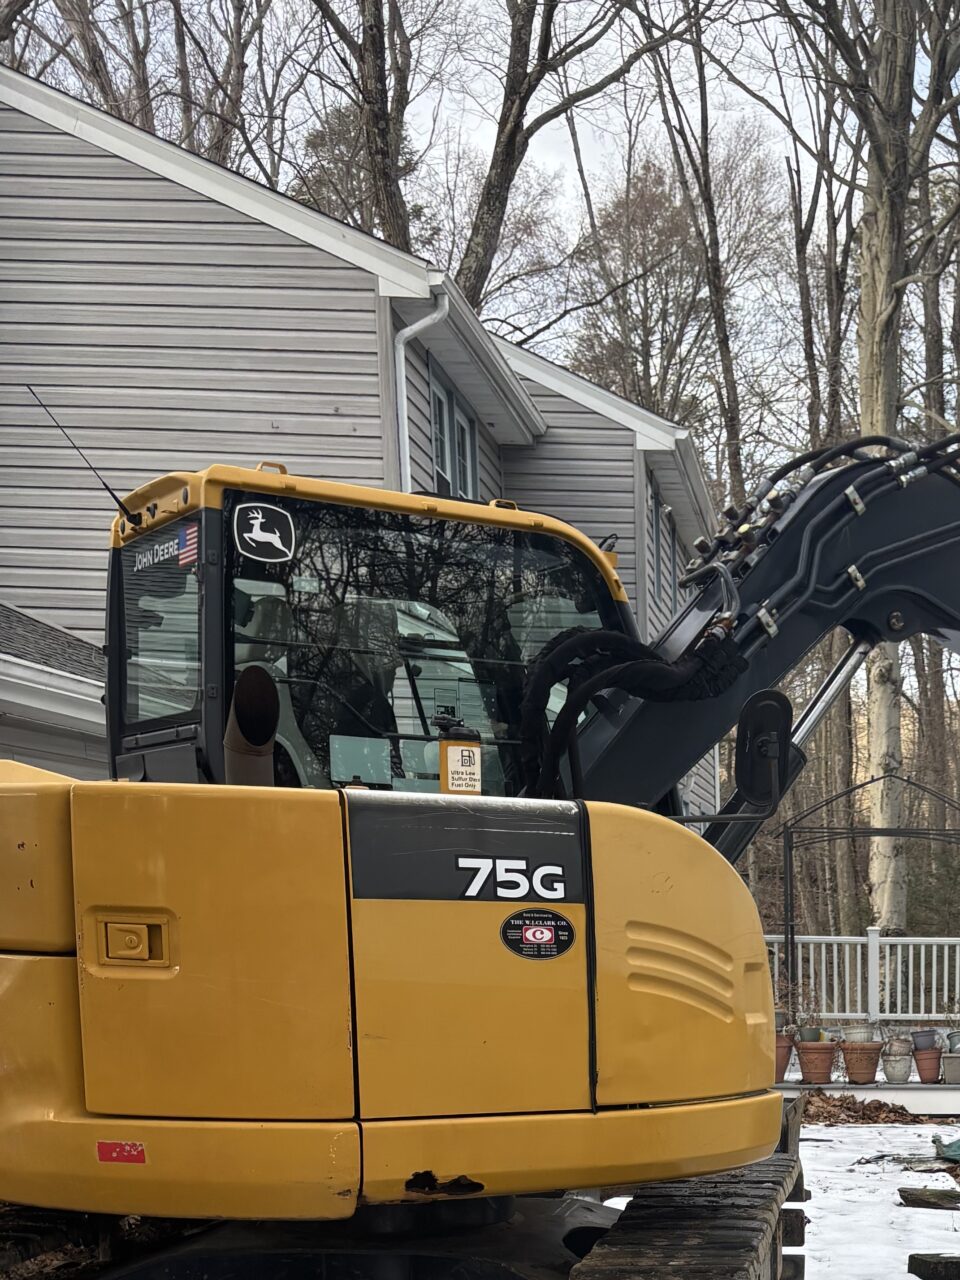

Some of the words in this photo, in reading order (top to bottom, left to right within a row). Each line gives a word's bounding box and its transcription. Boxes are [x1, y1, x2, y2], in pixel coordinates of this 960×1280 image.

[134, 551, 153, 572] JOHN
[154, 539, 179, 564] DEERE
[458, 857, 565, 899] 75G
[532, 929, 545, 940] C
